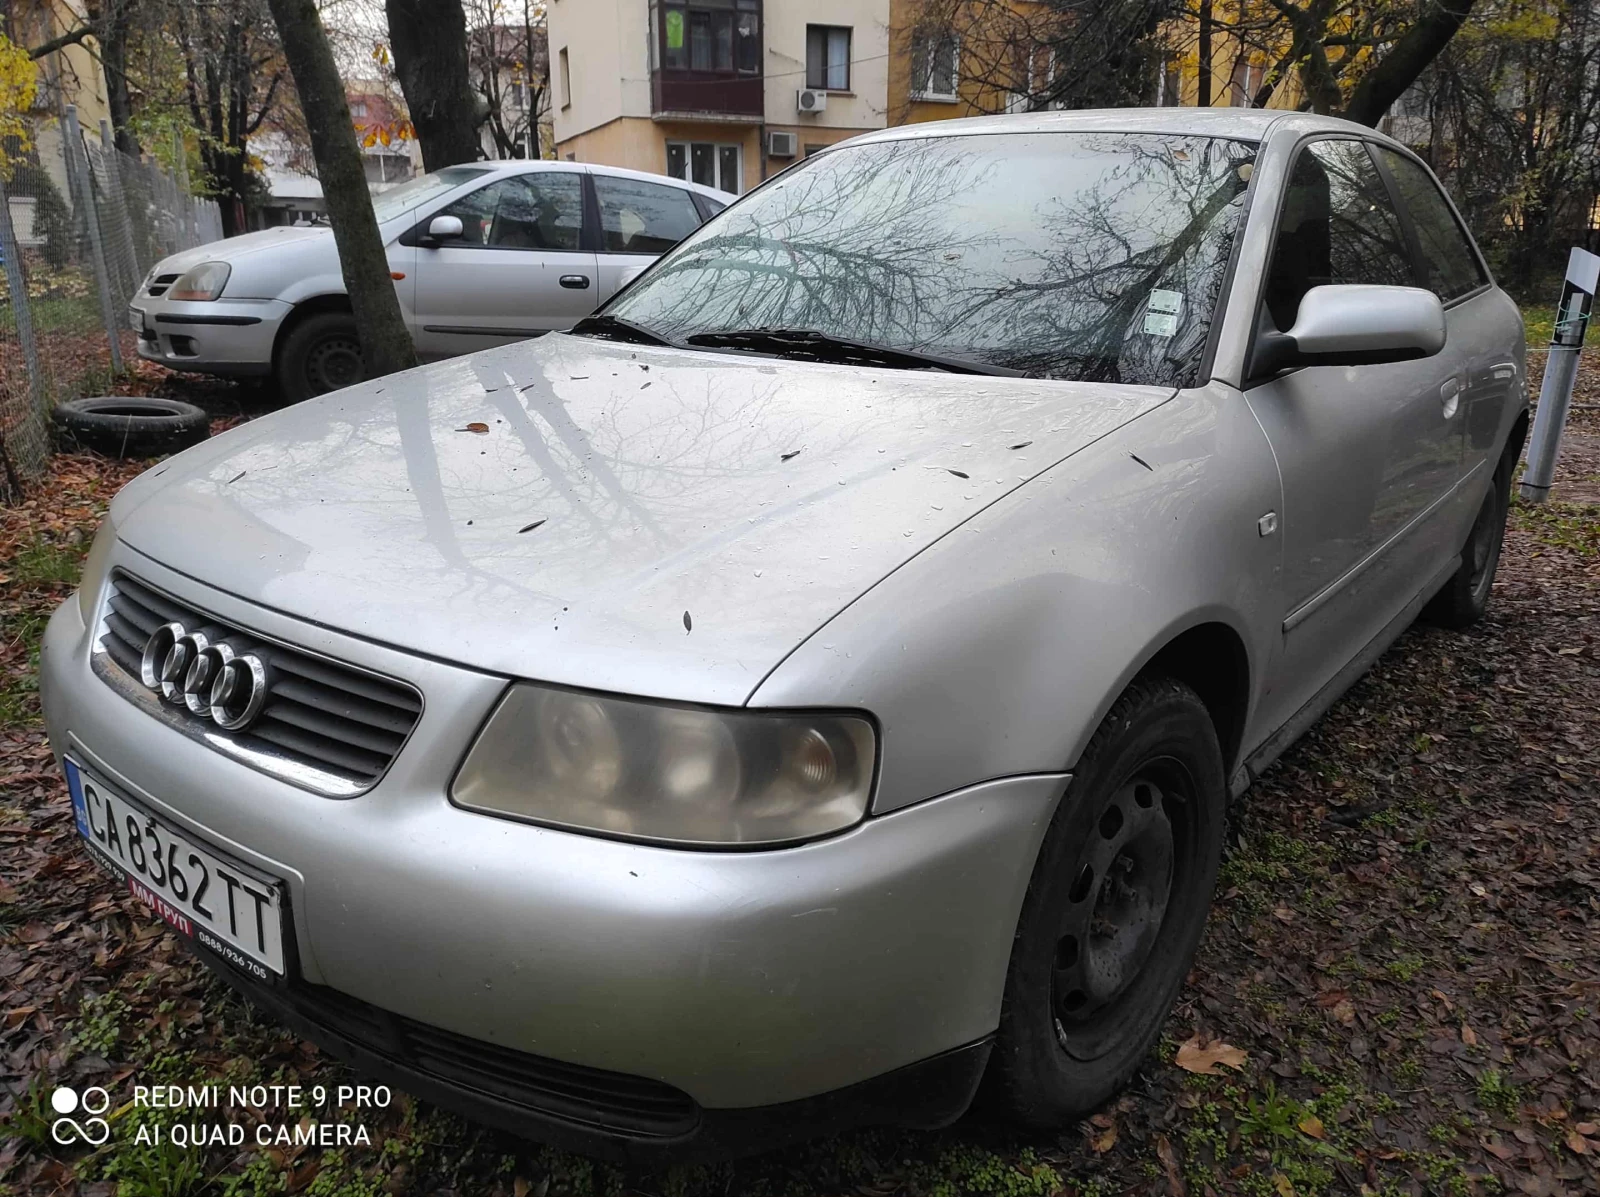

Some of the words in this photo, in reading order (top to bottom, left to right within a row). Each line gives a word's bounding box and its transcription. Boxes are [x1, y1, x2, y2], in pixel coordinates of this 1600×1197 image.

[75, 804, 88, 827] BG
[157, 896, 190, 935] ГРУП
[198, 931, 246, 967] 0888/936
[247, 960, 267, 980] 705
